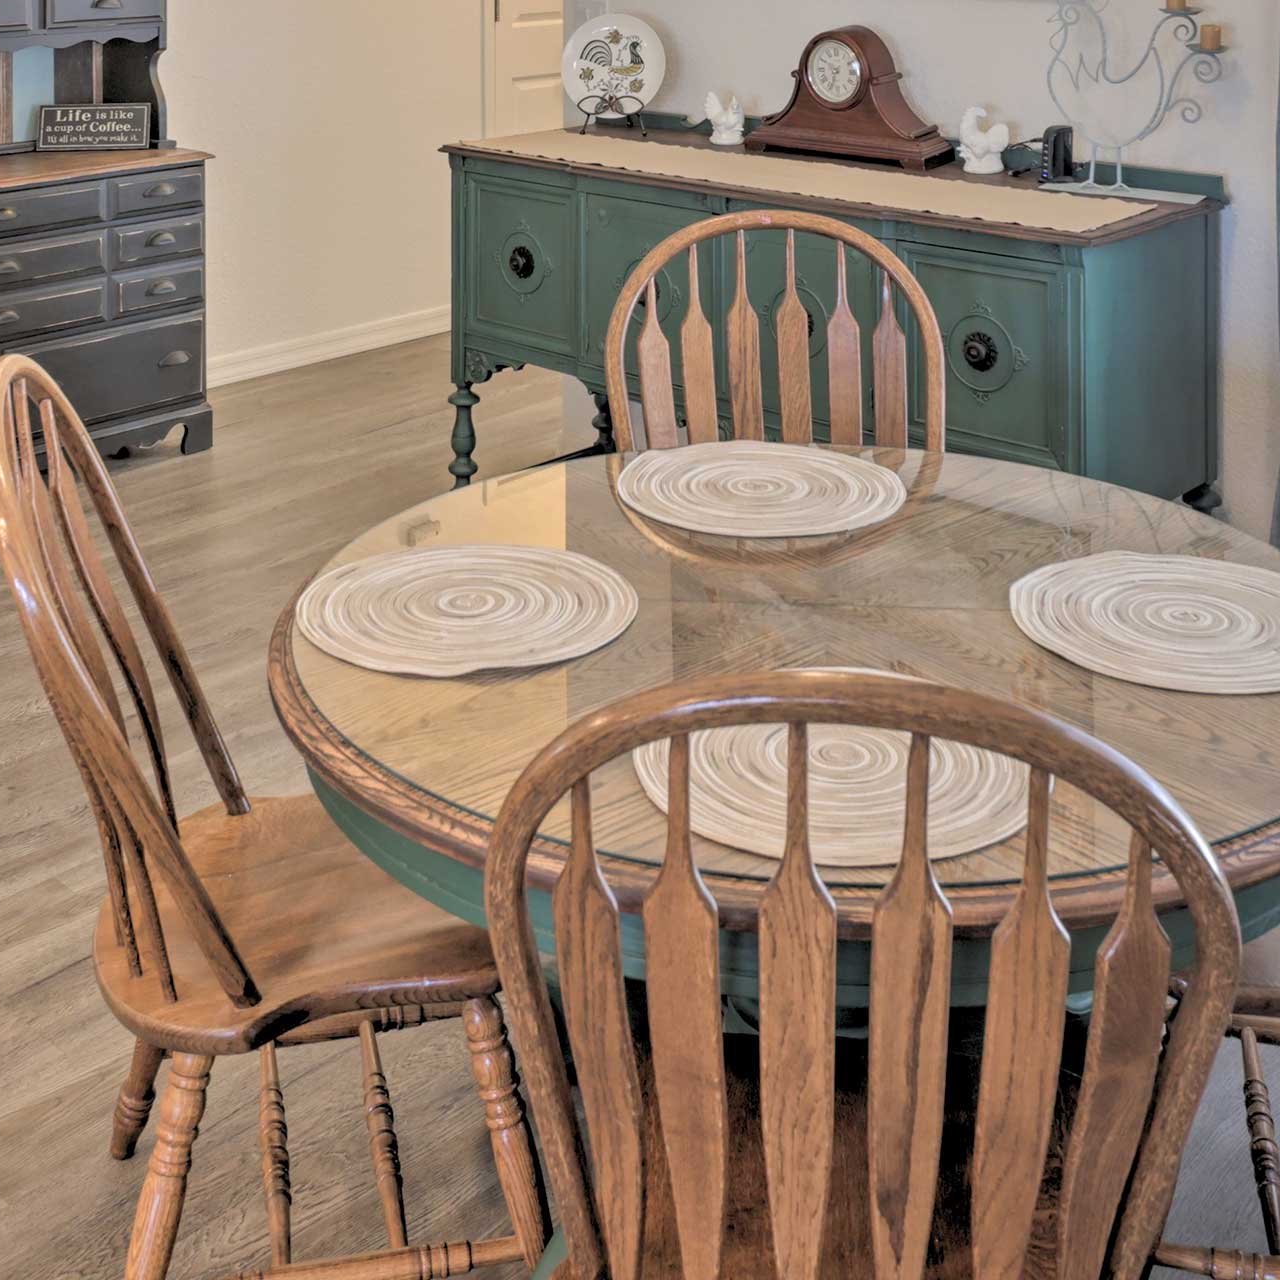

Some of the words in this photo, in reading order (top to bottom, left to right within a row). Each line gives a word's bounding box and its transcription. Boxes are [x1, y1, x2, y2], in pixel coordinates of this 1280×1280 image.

[56, 109, 92, 122] Life
[96, 110, 107, 120] is
[109, 110, 134, 120] like
[54, 124, 74, 134] cup
[75, 123, 88, 132] of
[89, 121, 142, 133] Coffee...
[59, 134, 69, 144] all
[93, 135, 108, 145] you
[109, 132, 129, 143] make
